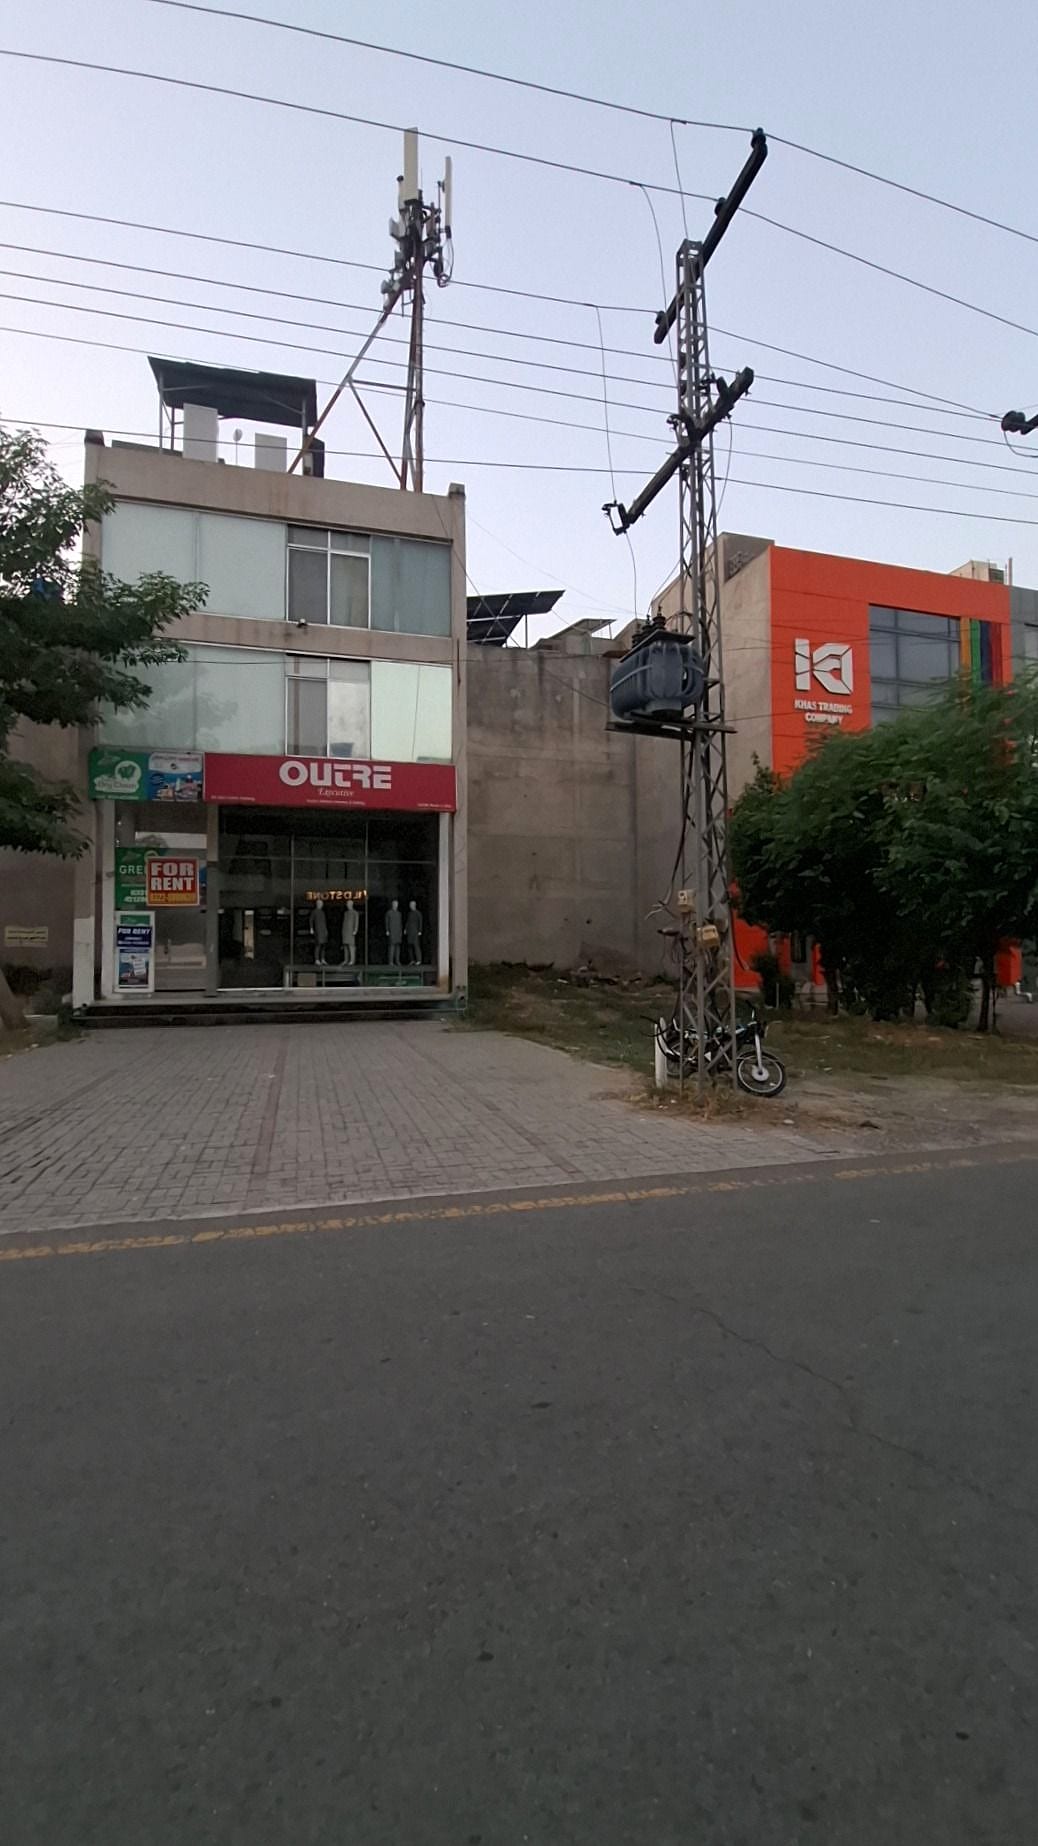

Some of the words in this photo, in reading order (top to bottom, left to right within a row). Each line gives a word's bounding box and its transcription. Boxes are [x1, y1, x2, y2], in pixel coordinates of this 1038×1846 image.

[794, 699, 817, 711] KHAS
[817, 701, 853, 714] TRADING
[279, 760, 392, 790] OUTRE
[151, 862, 194, 876] FOR
[151, 877, 194, 890] RENT
